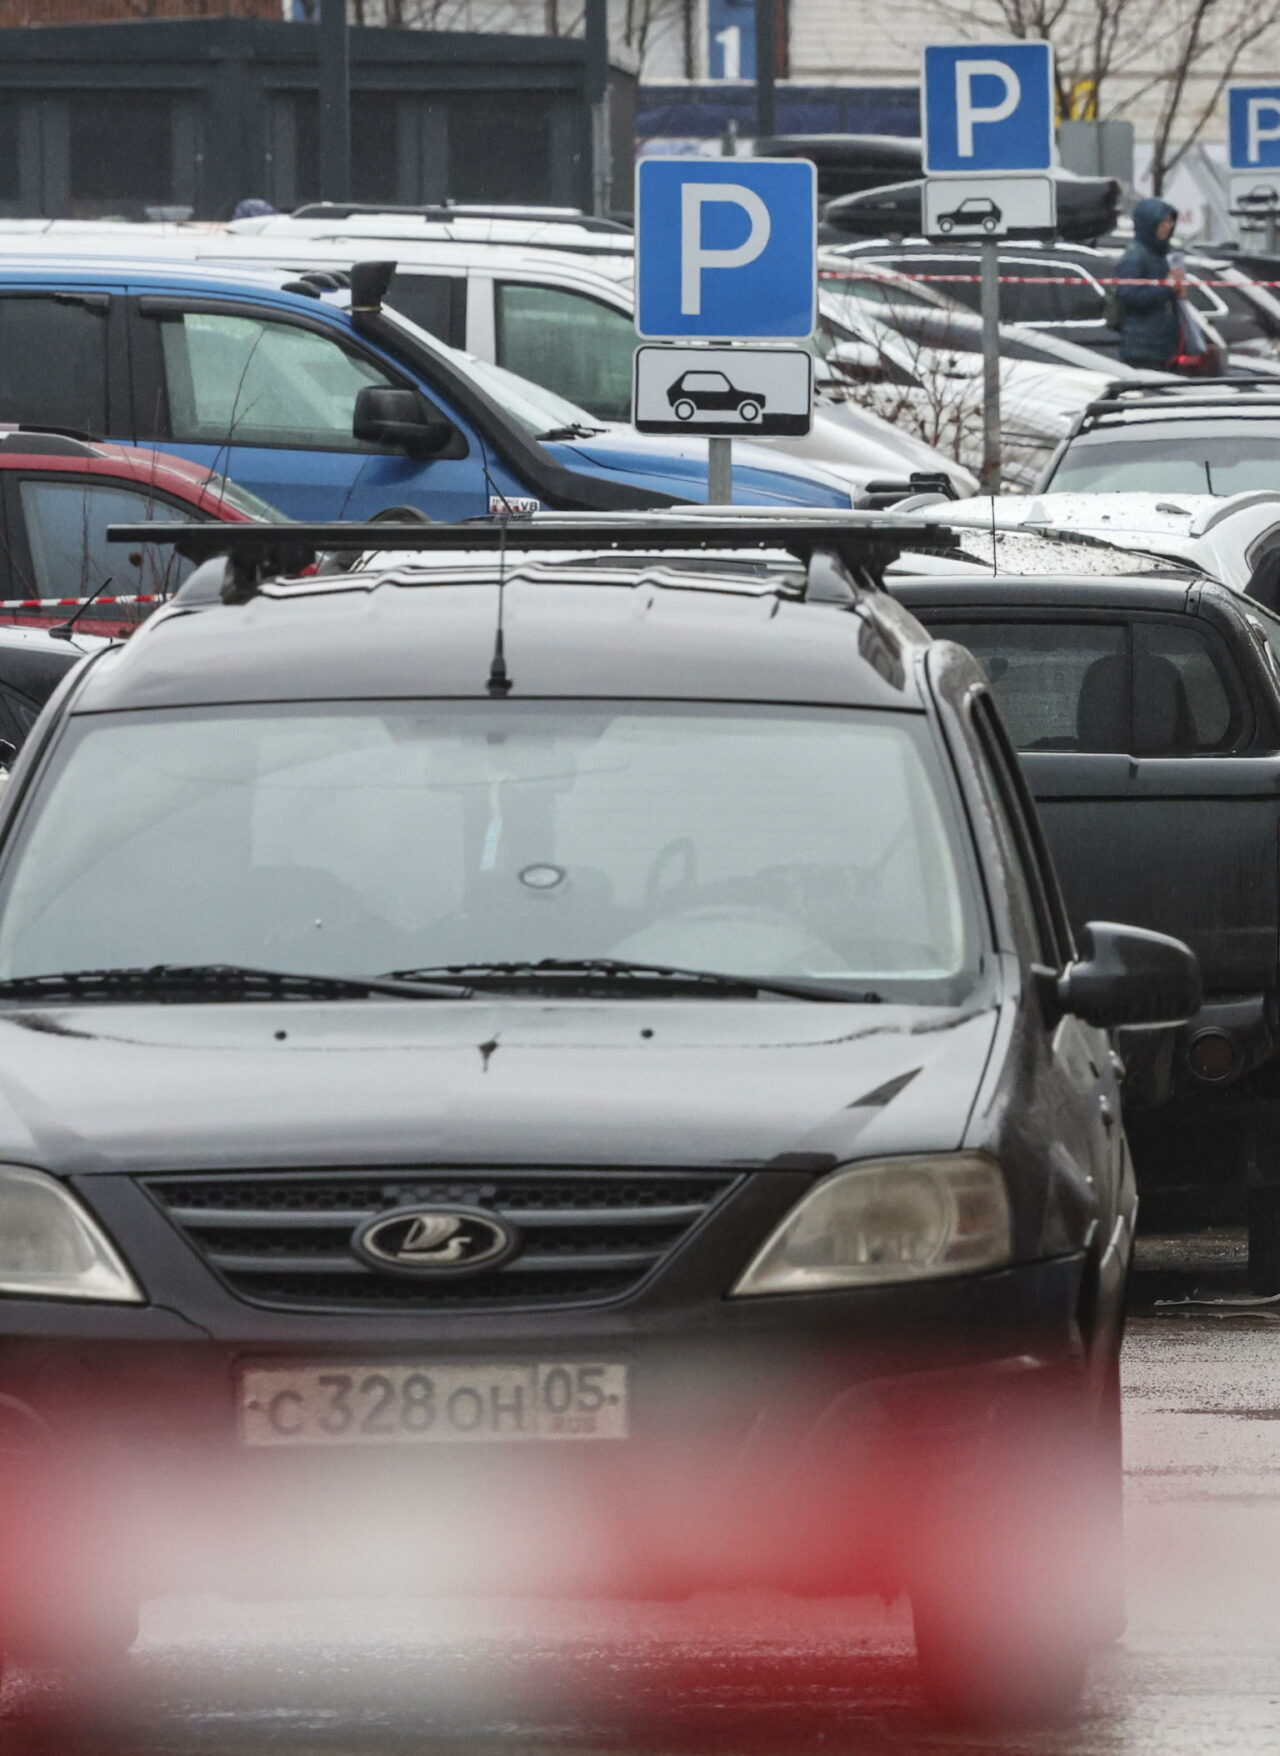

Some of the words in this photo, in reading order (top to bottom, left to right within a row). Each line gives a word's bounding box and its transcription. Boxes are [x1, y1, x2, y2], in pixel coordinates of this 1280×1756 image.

[715, 25, 741, 80] 1
[955, 59, 1022, 158] P
[680, 183, 772, 316] P
[542, 1367, 605, 1414] 05
